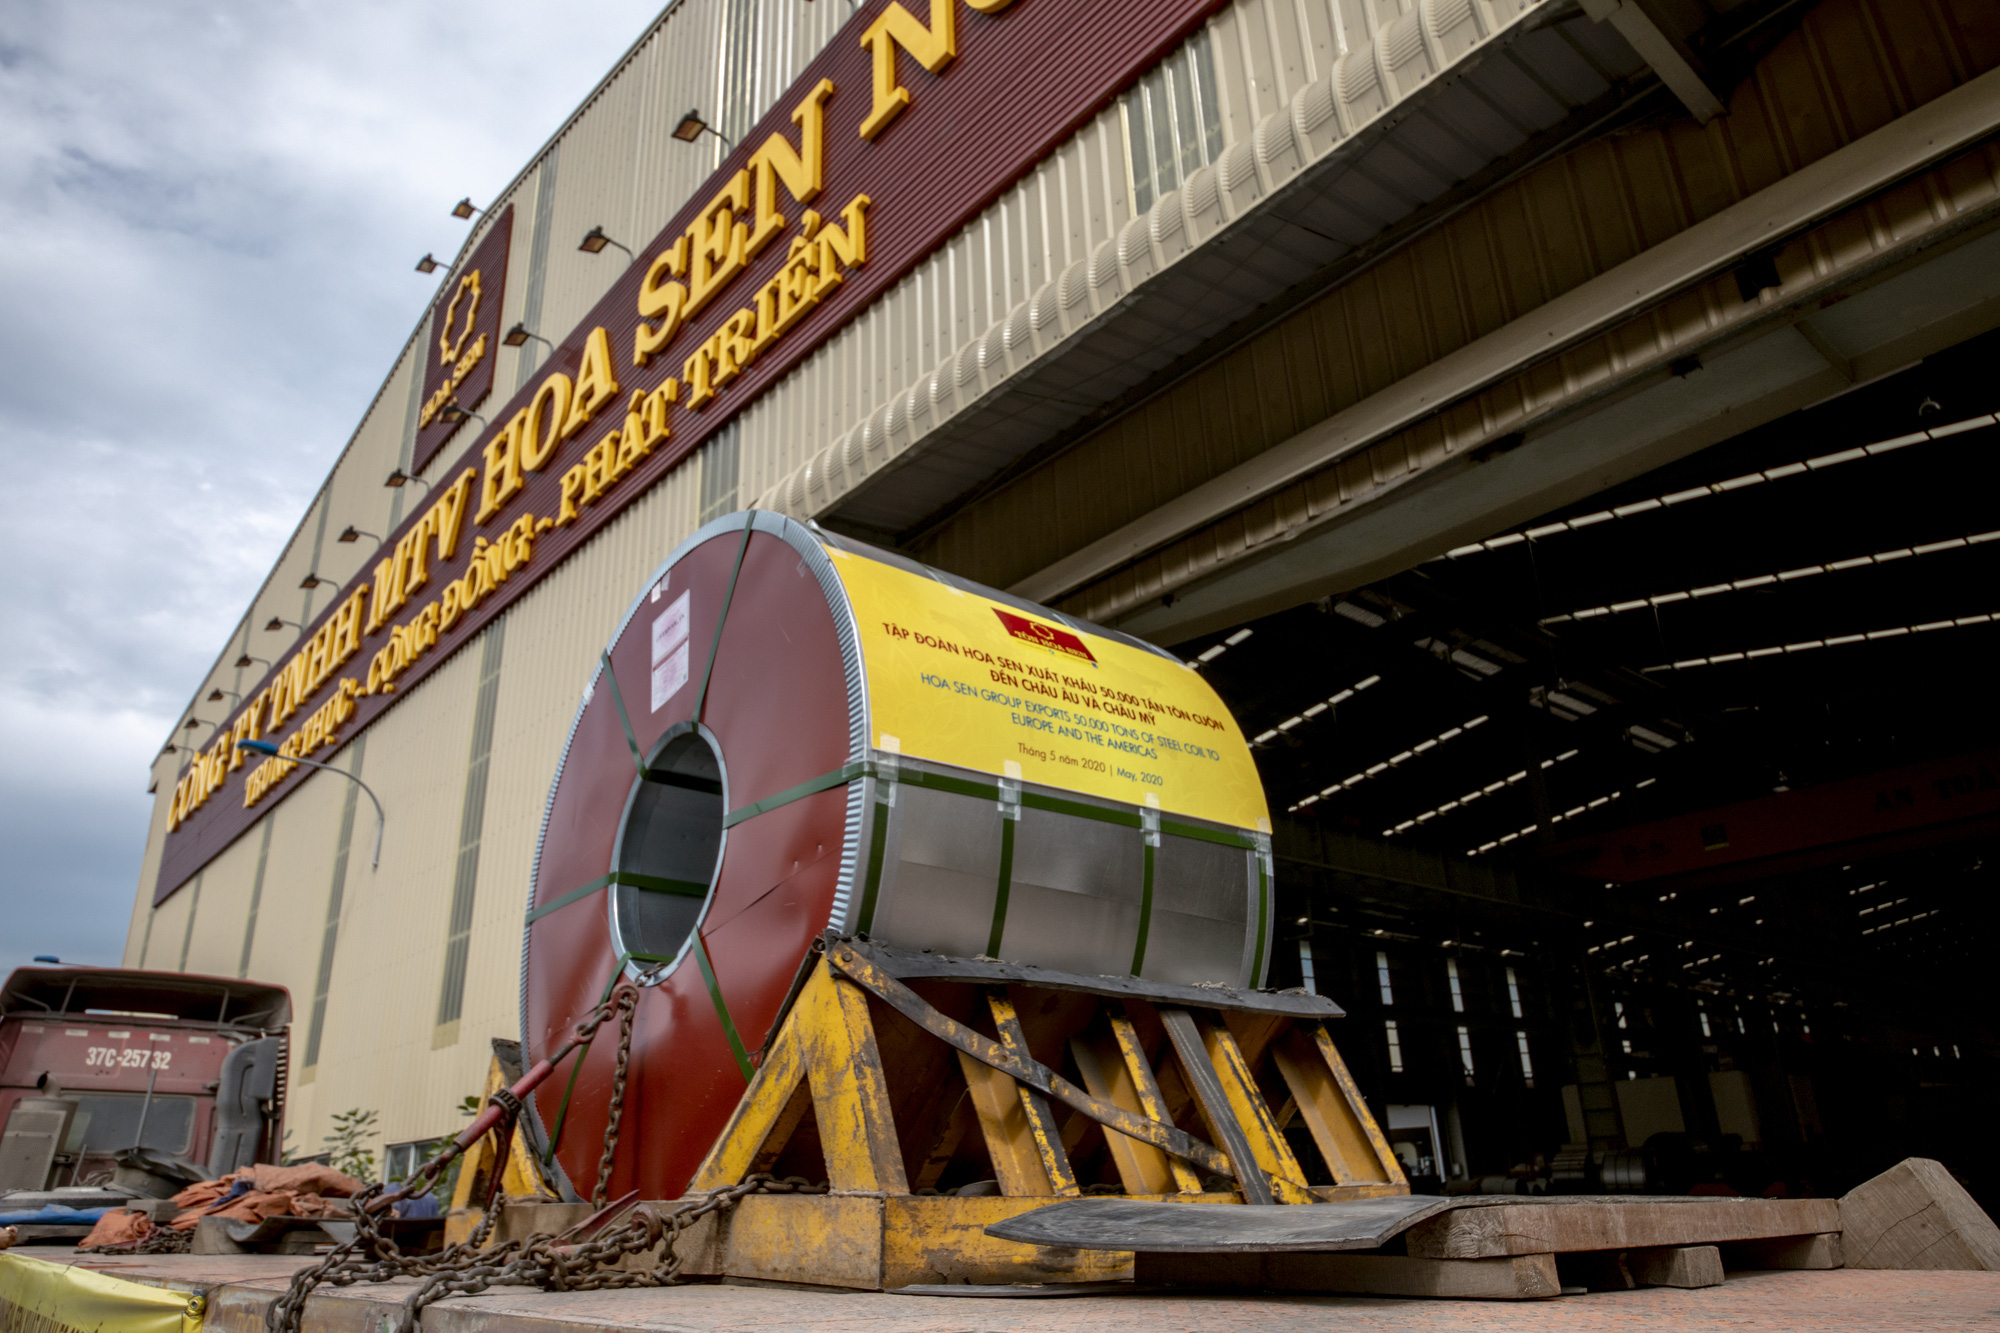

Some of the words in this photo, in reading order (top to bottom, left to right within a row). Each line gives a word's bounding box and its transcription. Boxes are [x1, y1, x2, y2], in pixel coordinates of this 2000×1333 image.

[166, 731, 231, 833] CÔNG
[228, 687, 271, 773] TY
[266, 583, 369, 734] TNHH
[364, 467, 476, 636] MTV
[474, 326, 619, 527] HOA
[633, 77, 833, 367] SEN
[367, 601, 439, 695] CỘNG
[437, 513, 534, 633] ĐỒNG
[555, 377, 678, 527] PHÁT
[683, 194, 871, 410] TRIỂN
[882, 622, 909, 641] TẬP
[914, 632, 960, 655] ĐOÀN
[962, 646, 995, 666] HOA
[997, 656, 1024, 674] SEN
[1026, 664, 1059, 683] XUẤT
[1100, 686, 1140, 707] 50.000
[1166, 705, 1191, 722] TÔN
[920, 672, 951, 691] HOA
[953, 681, 978, 698] SEN
[981, 689, 1022, 709] GROUP
[1025, 700, 1071, 723] EXPORTS
[1073, 713, 1109, 732] 50.000
[1110, 723, 1139, 741] TONS
[1141, 731, 1155, 745] OF
[1157, 735, 1183, 753] STEEL
[1184, 743, 1206, 759] COIL
[1206, 748, 1220, 762] TO
[1021, 679, 1058, 699] CHÂU
[1062, 687, 1080, 705] ÂU
[1081, 694, 1101, 711] VÀ
[1103, 702, 1136, 721] CHÂU
[1011, 712, 1055, 734] EUROPE
[1058, 725, 1083, 741] AND
[1084, 731, 1104, 747] THE
[1107, 738, 1159, 760] AMERICAS
[1018, 742, 1047, 762] Tháng
[1050, 750, 1056, 762] 5
[1059, 753, 1079, 767] năm
[1081, 758, 1106, 773] 2020
[1117, 767, 1138, 783] May,
[1140, 771, 1164, 787] 2020
